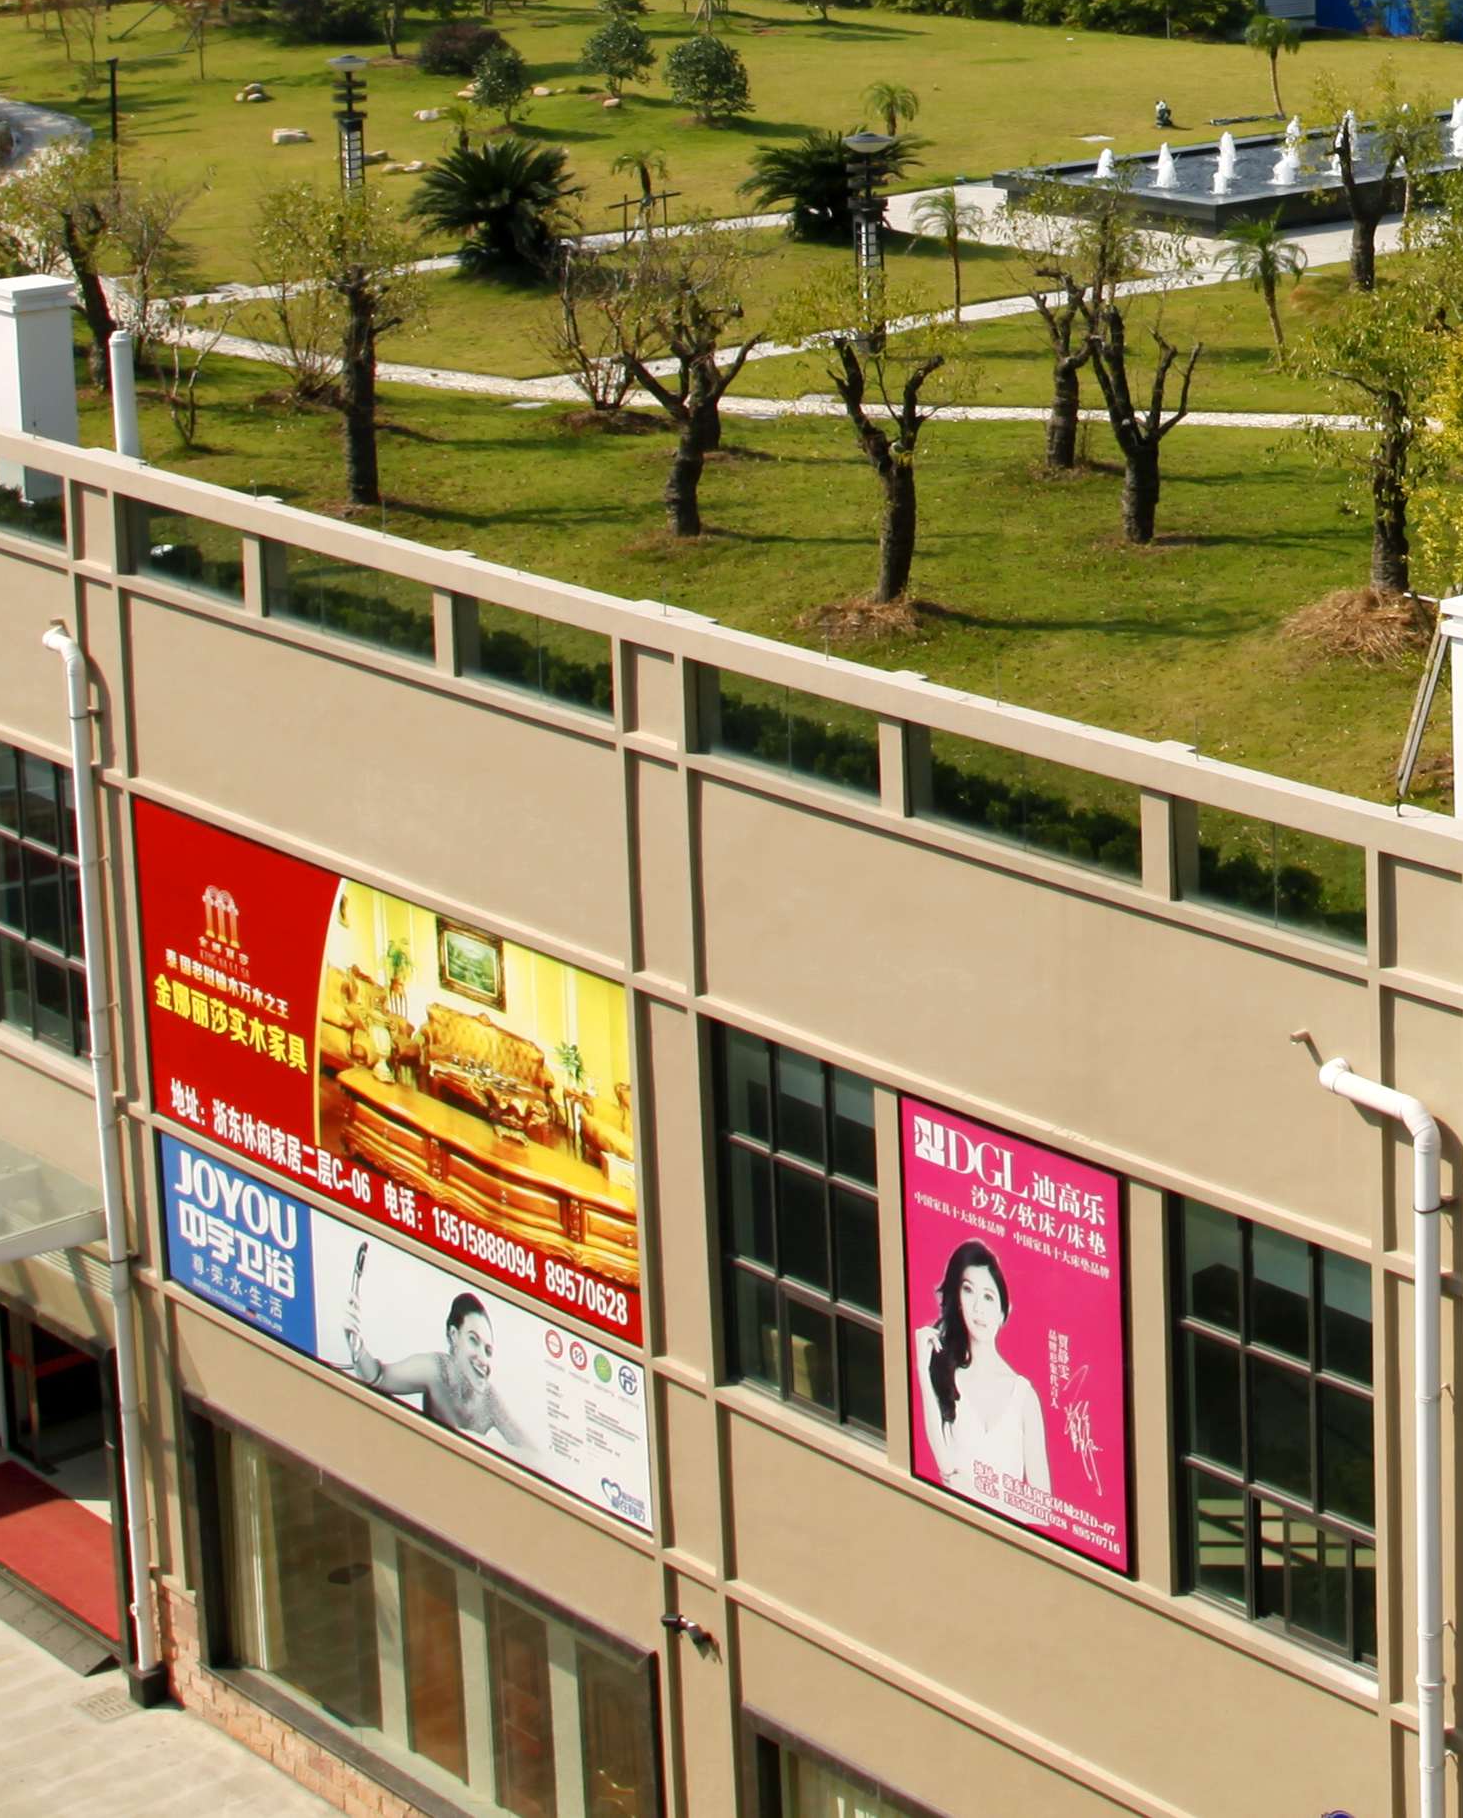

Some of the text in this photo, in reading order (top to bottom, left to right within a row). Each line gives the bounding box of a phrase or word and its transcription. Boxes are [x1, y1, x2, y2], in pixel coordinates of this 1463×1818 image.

[154, 973, 308, 1074] 金娜丽莎实木家具
[173, 1149, 297, 1250] JOYOU
[212, 1098, 371, 1203] 浙东休闲家居二层C-06
[432, 1206, 537, 1283] 13515888094
[545, 1260, 629, 1326] 89570628
[946, 1127, 1106, 1226] DGL 迪高乐
[971, 1185, 1107, 1259] 沙发/软床/床垫
[178, 1198, 296, 1299] 中宇卫浴
[1072, 1523, 1121, 1554] 89570716
